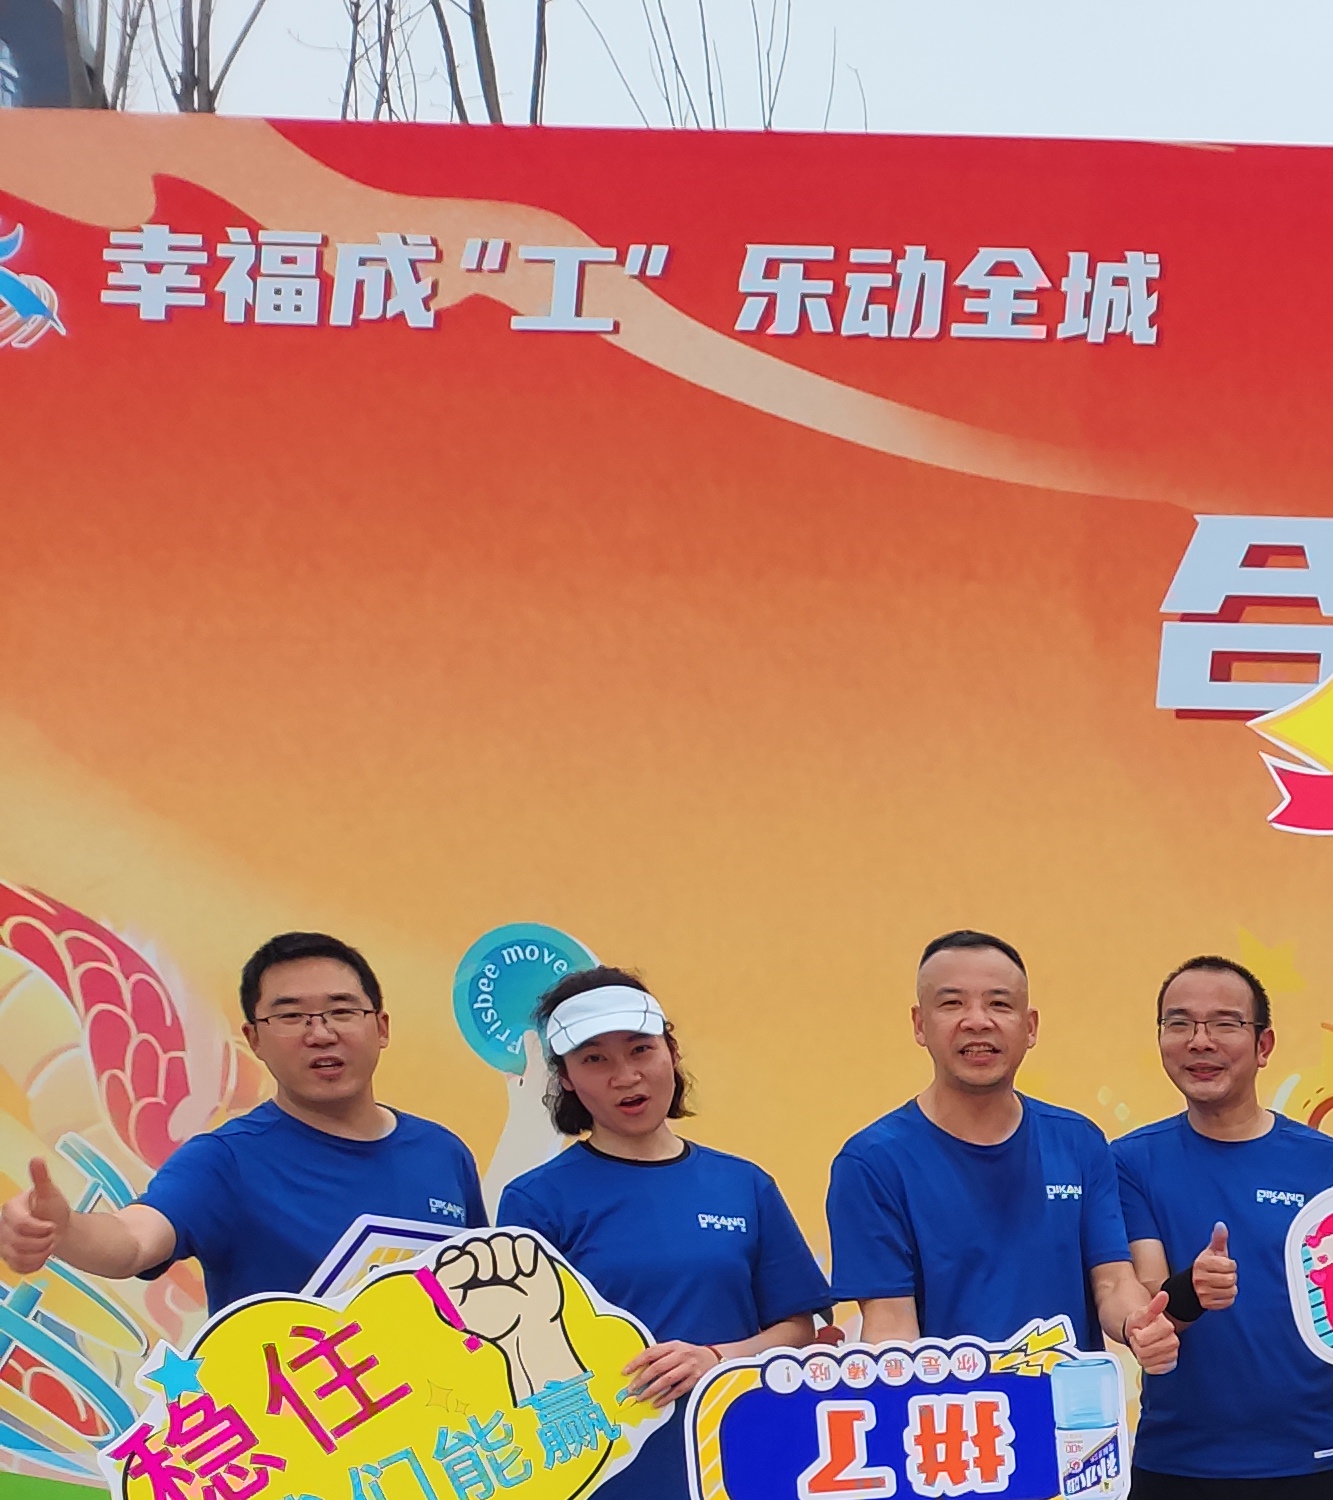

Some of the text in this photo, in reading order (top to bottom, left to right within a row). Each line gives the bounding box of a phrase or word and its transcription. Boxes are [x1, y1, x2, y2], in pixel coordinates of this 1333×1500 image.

[733, 243, 1161, 345] 乐动全城
[1046, 1185, 1082, 1195] DIKAN
[808, 1400, 1005, 1495] 拼了
